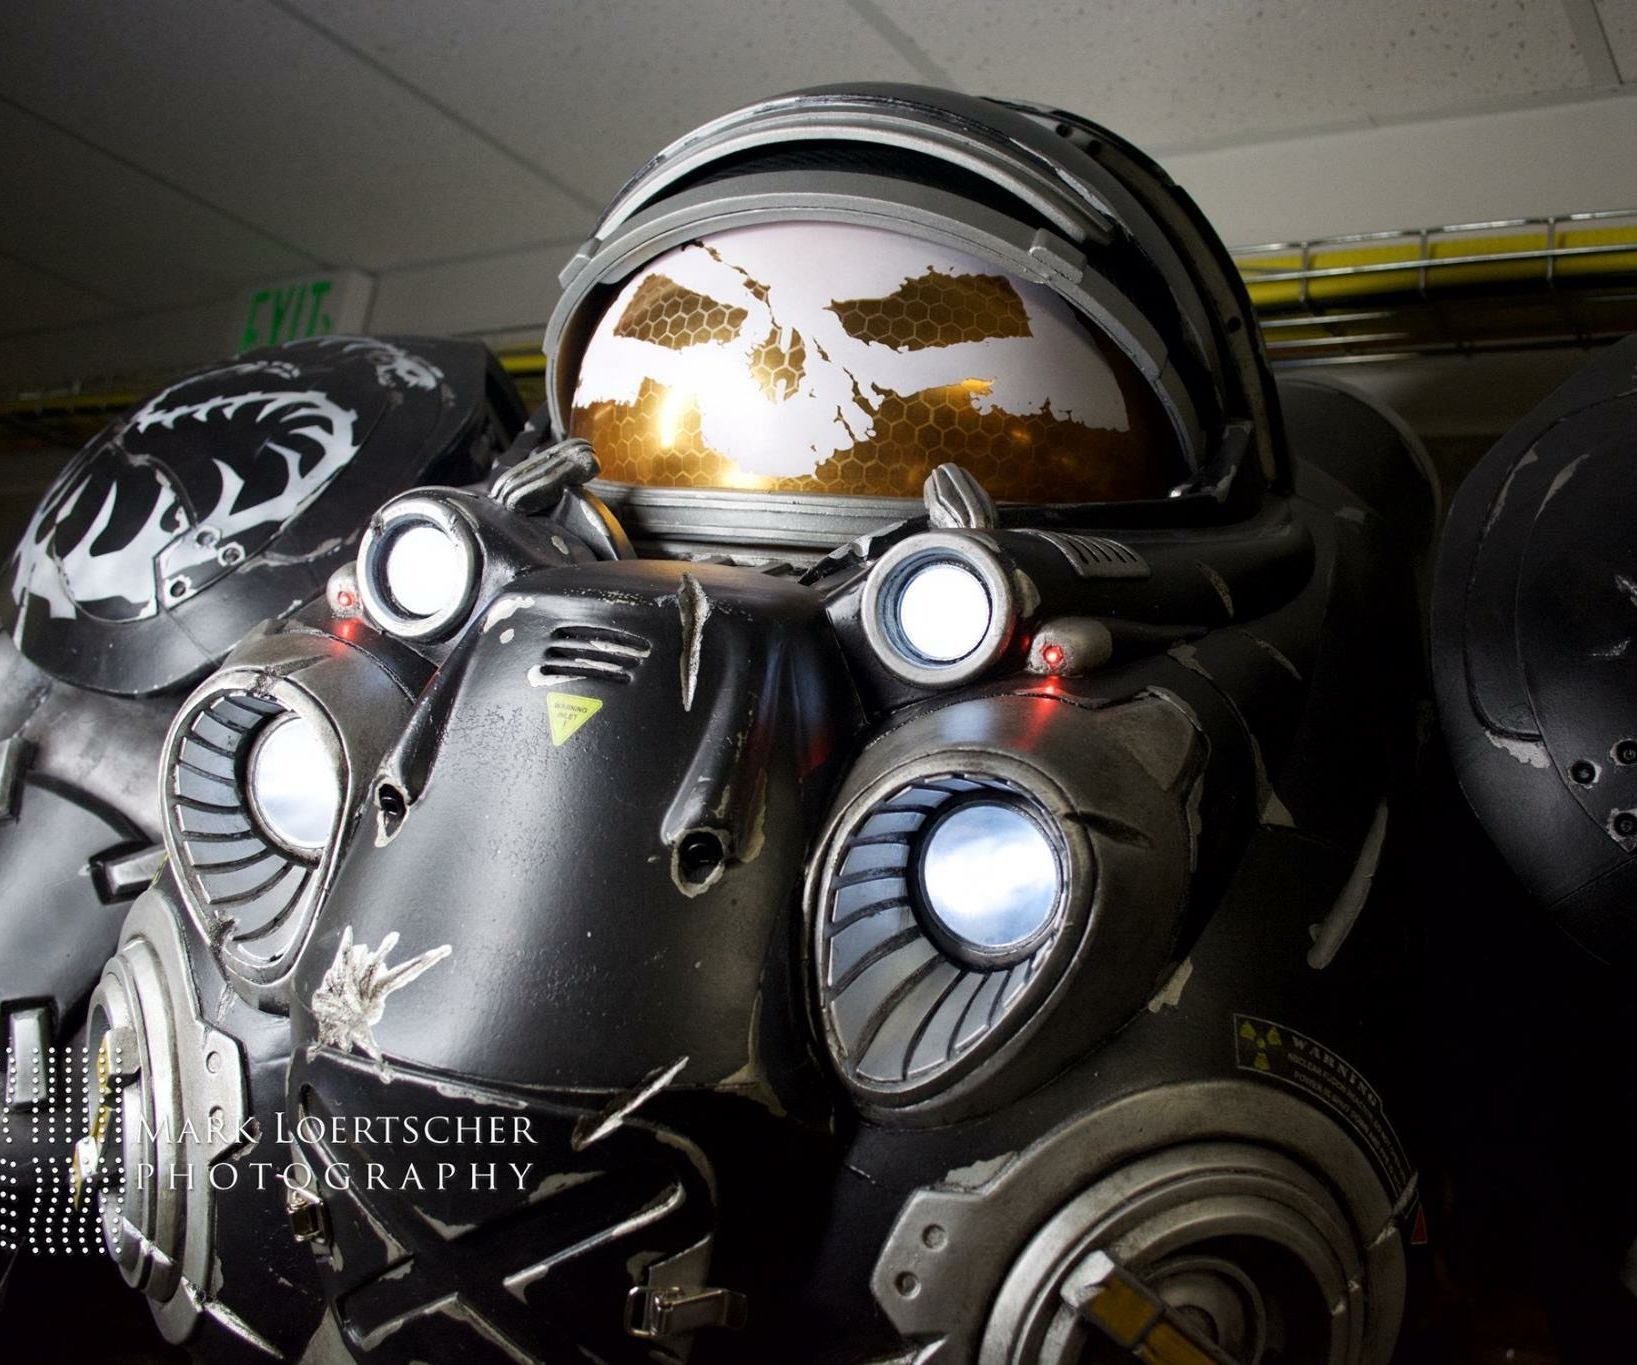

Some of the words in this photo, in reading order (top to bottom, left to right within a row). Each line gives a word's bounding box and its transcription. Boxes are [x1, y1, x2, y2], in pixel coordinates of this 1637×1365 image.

[239, 281, 332, 351] EXIT
[555, 703, 588, 714] WARNING
[1292, 1035, 1377, 1106] WARNING
